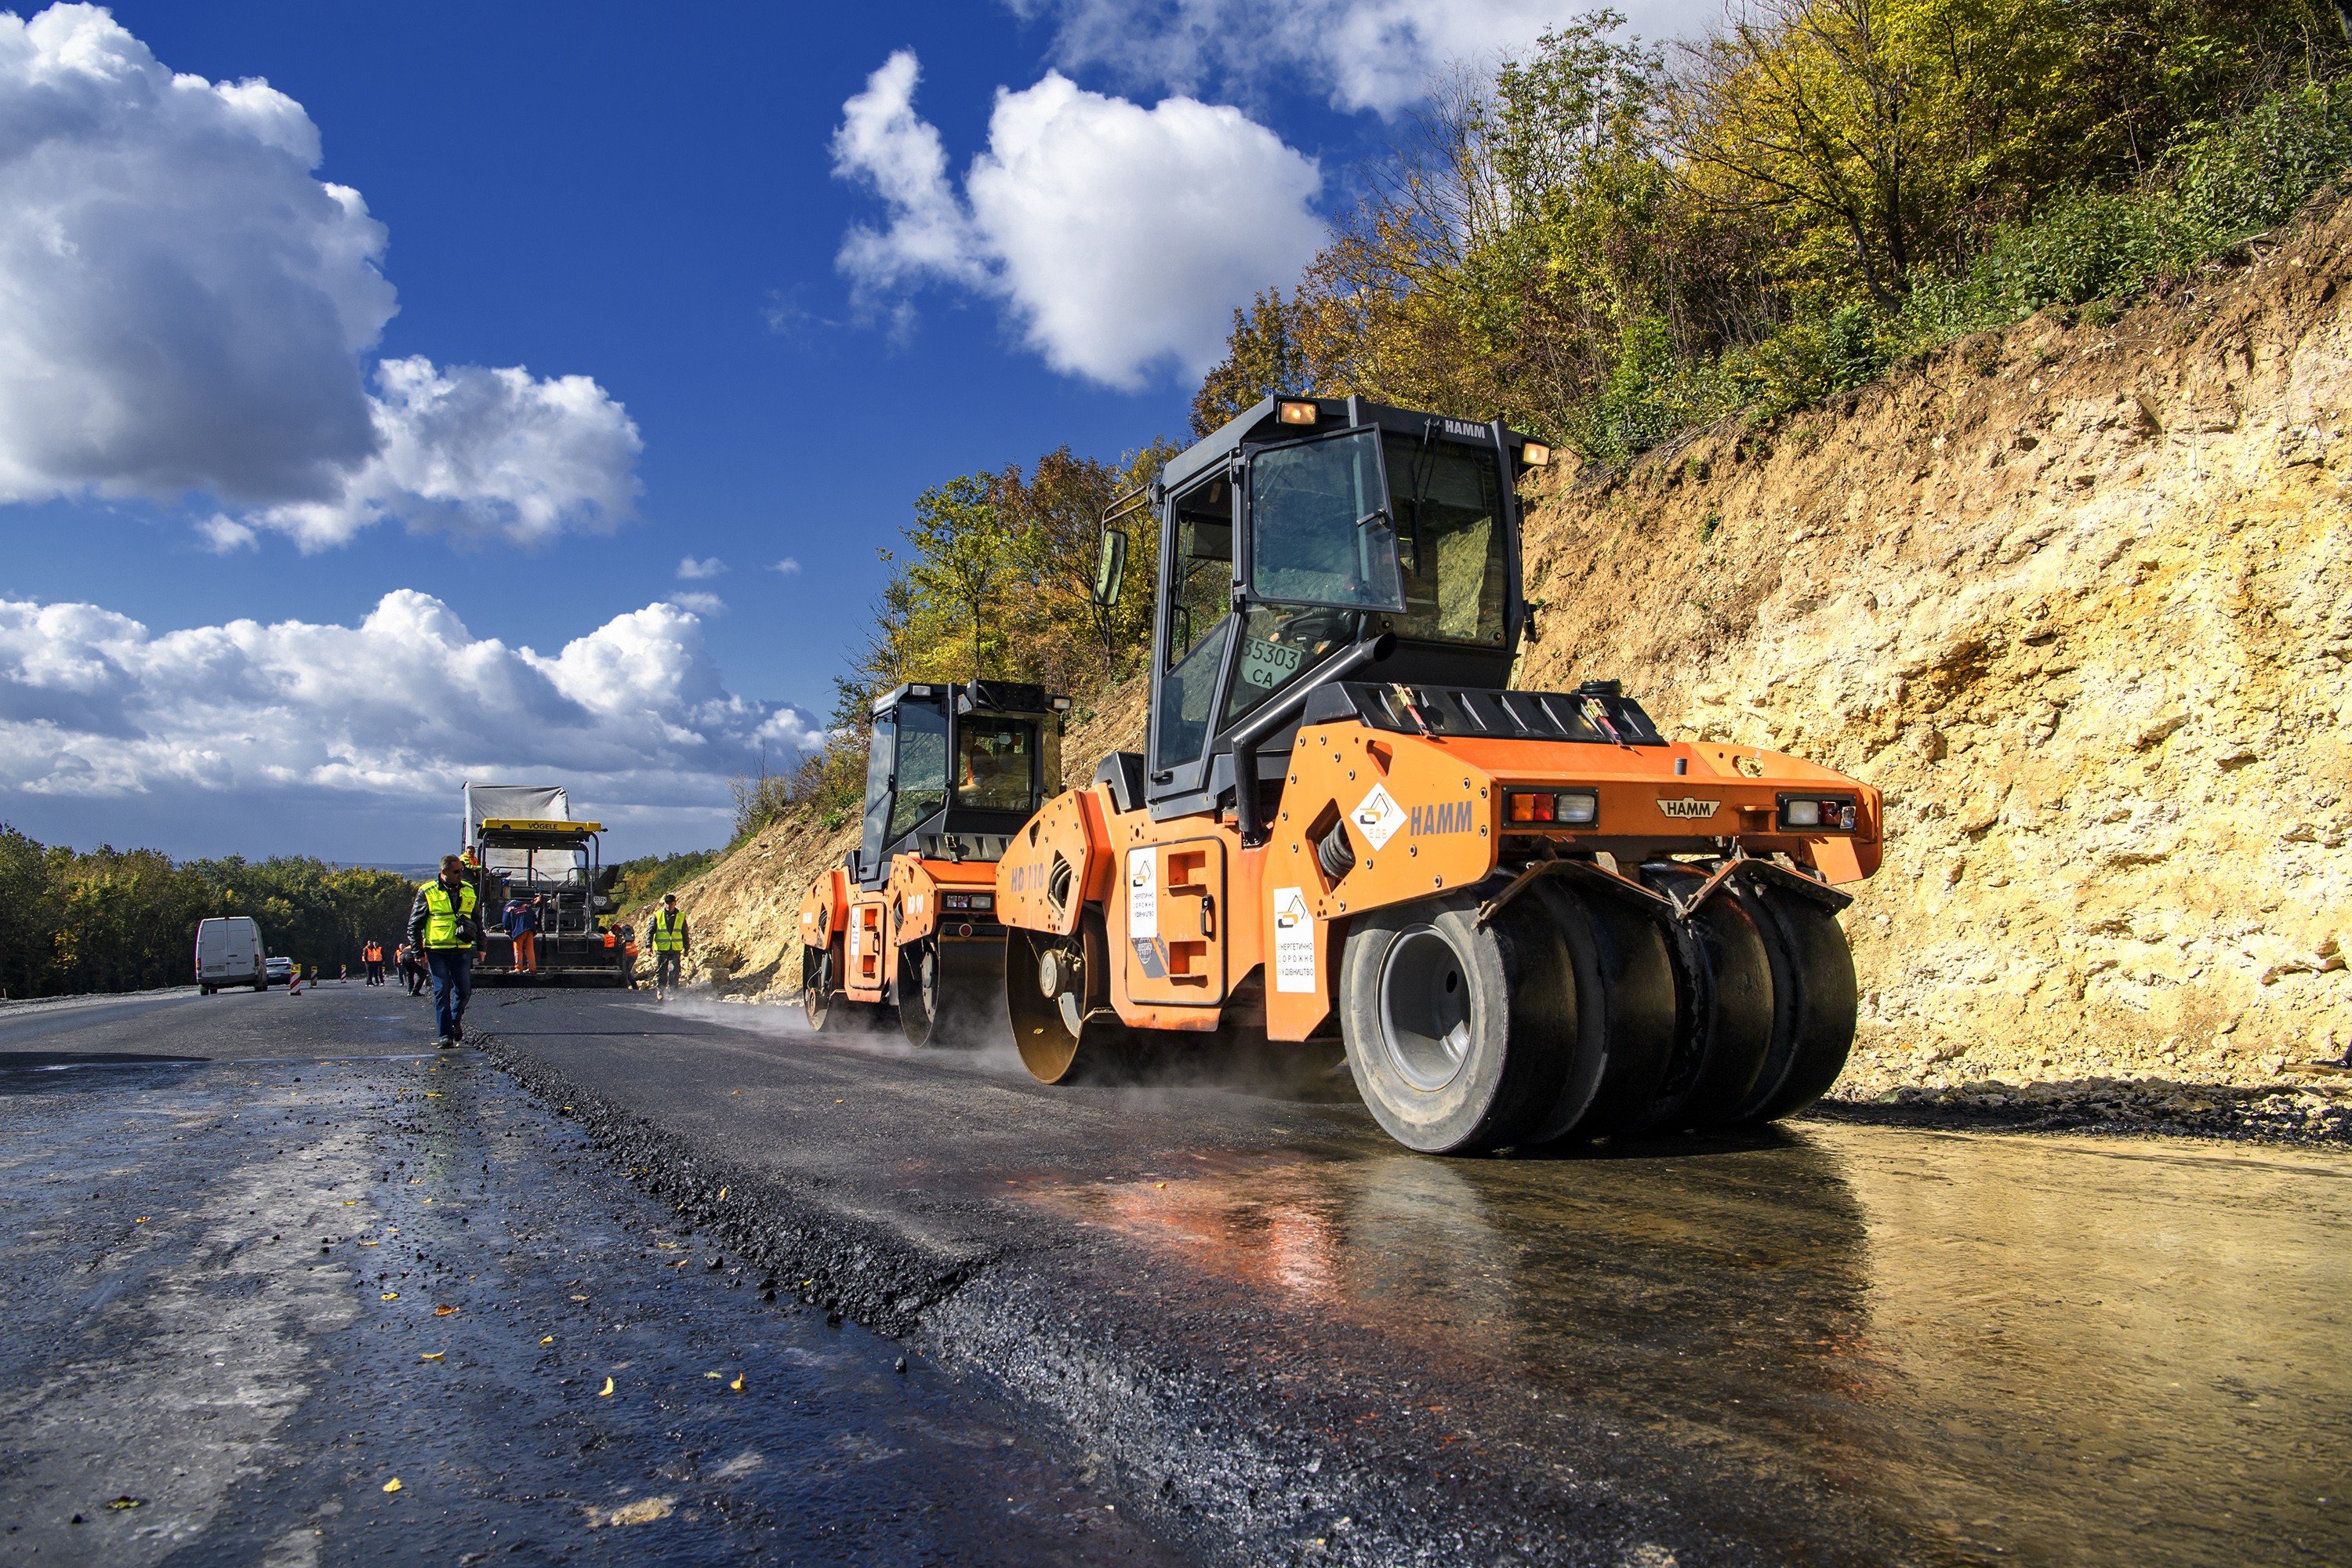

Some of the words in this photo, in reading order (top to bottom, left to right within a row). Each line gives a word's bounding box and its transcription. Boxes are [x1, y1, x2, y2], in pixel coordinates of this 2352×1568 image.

[1445, 419, 1485, 439] HAMM
[1243, 637, 1298, 670] 35303
[1252, 668, 1272, 688] CA
[1410, 800, 1472, 837] HAMM
[1667, 801, 1711, 816] HAMM
[528, 821, 558, 830] VÖGELE
[1011, 866, 1025, 892] HD
[1028, 862, 1044, 891] 110
